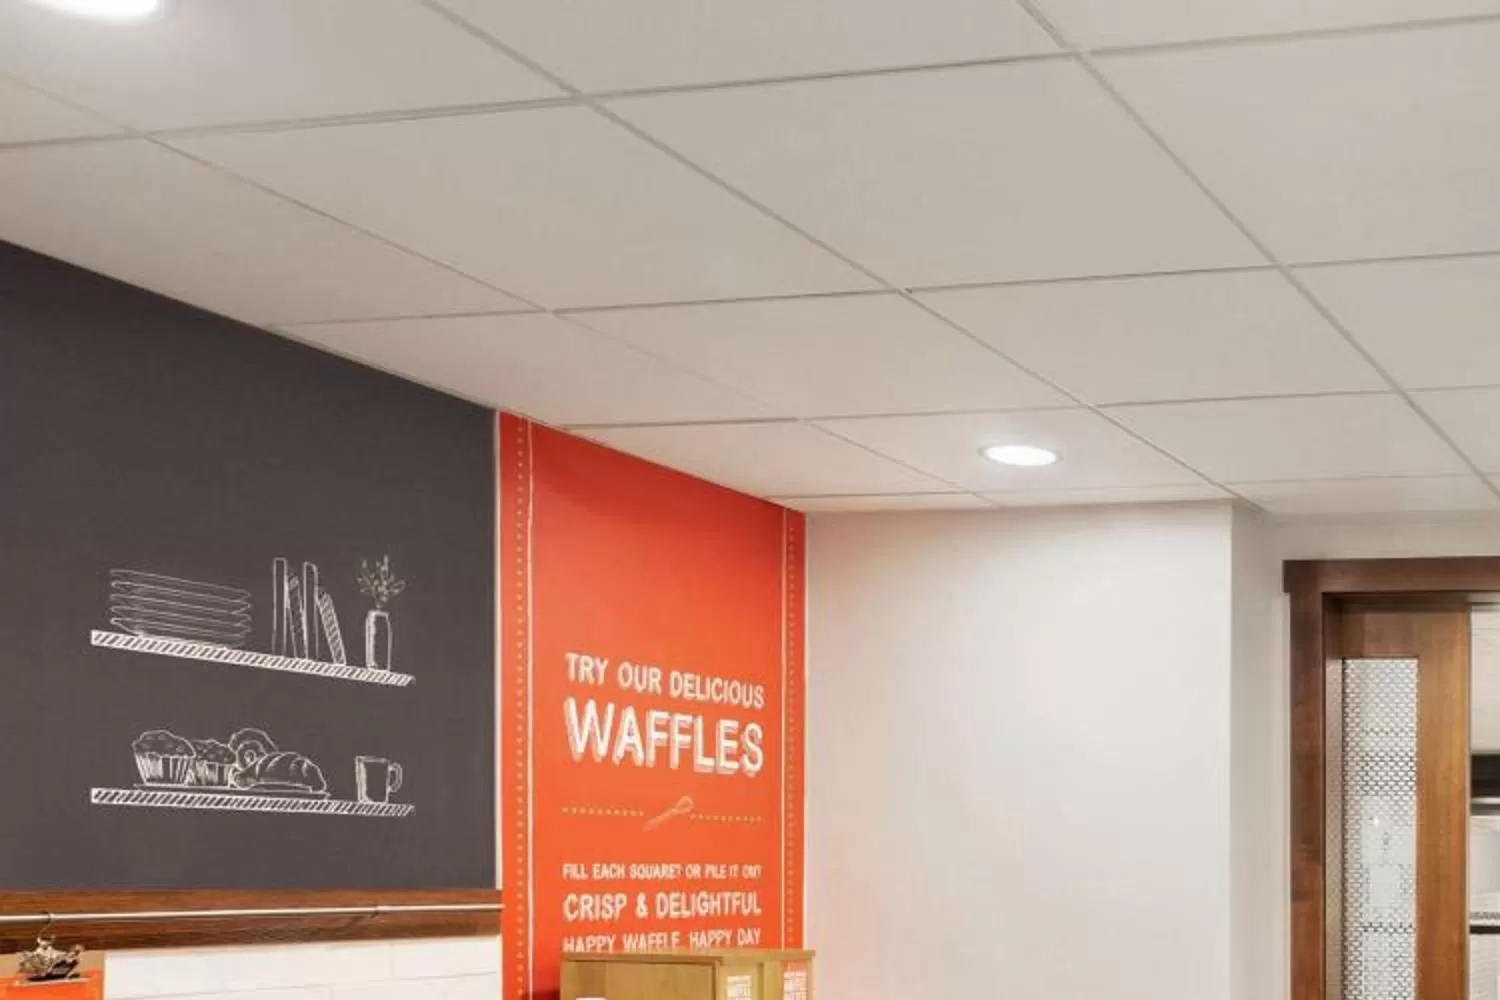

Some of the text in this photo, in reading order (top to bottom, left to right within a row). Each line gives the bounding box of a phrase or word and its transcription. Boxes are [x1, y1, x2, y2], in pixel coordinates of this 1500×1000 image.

[565, 652, 765, 710] TRY OUR DELICIOUS
[563, 696, 765, 778] WAFFLES
[563, 863, 588, 880] FILL
[593, 864, 625, 880] EACH
[685, 864, 701, 879] OR
[705, 864, 727, 879] PILE
[730, 864, 739, 878] IT
[564, 889, 762, 922] CRISP & DELIGHTFUL
[563, 934, 616, 953] HAPPY
[689, 928, 733, 950] HAPPY
[737, 928, 762, 946] DAY
